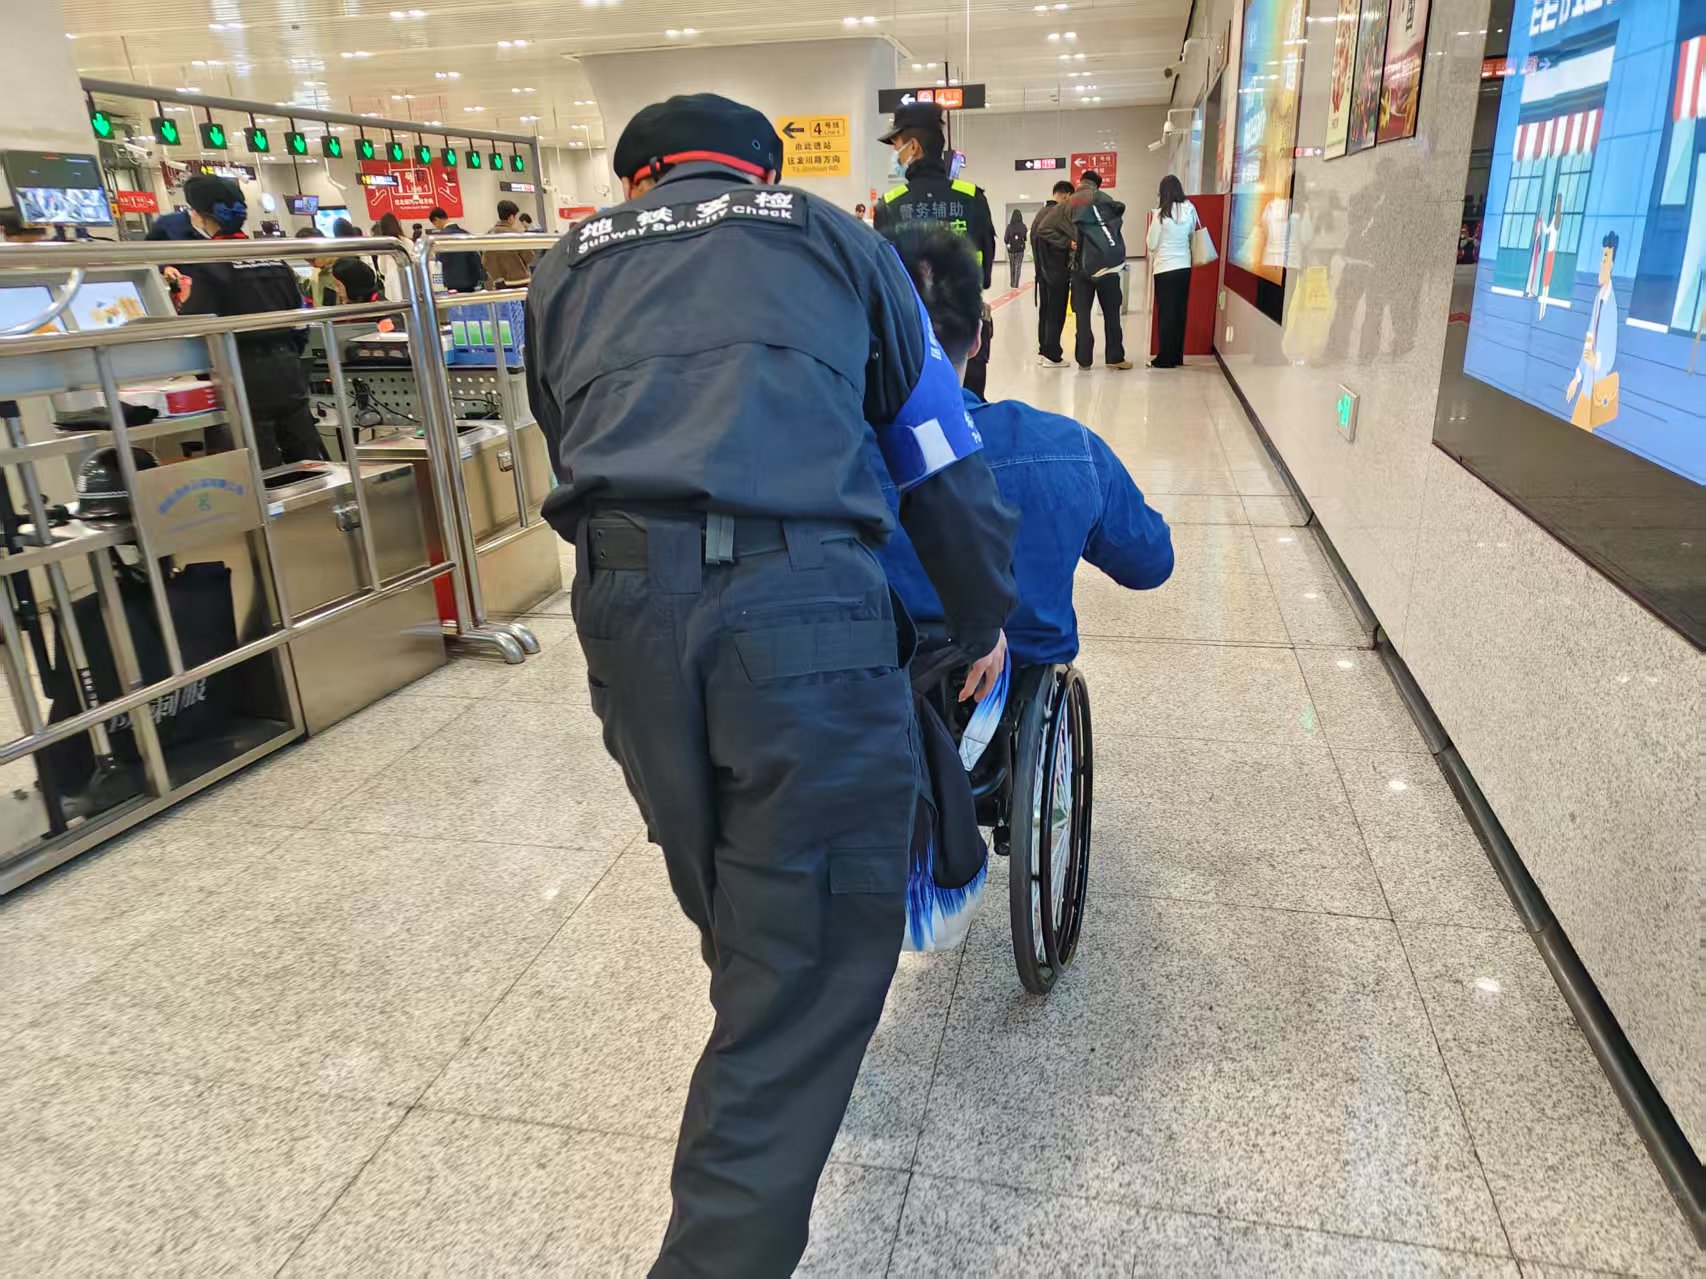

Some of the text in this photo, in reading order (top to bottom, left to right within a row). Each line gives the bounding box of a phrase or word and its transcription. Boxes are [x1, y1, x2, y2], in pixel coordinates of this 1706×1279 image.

[813, 122, 822, 135] 4
[795, 141, 831, 151] 由此进站
[900, 201, 963, 219] 警务辅助
[578, 226, 647, 255] Subway
[732, 204, 792, 220] Check
